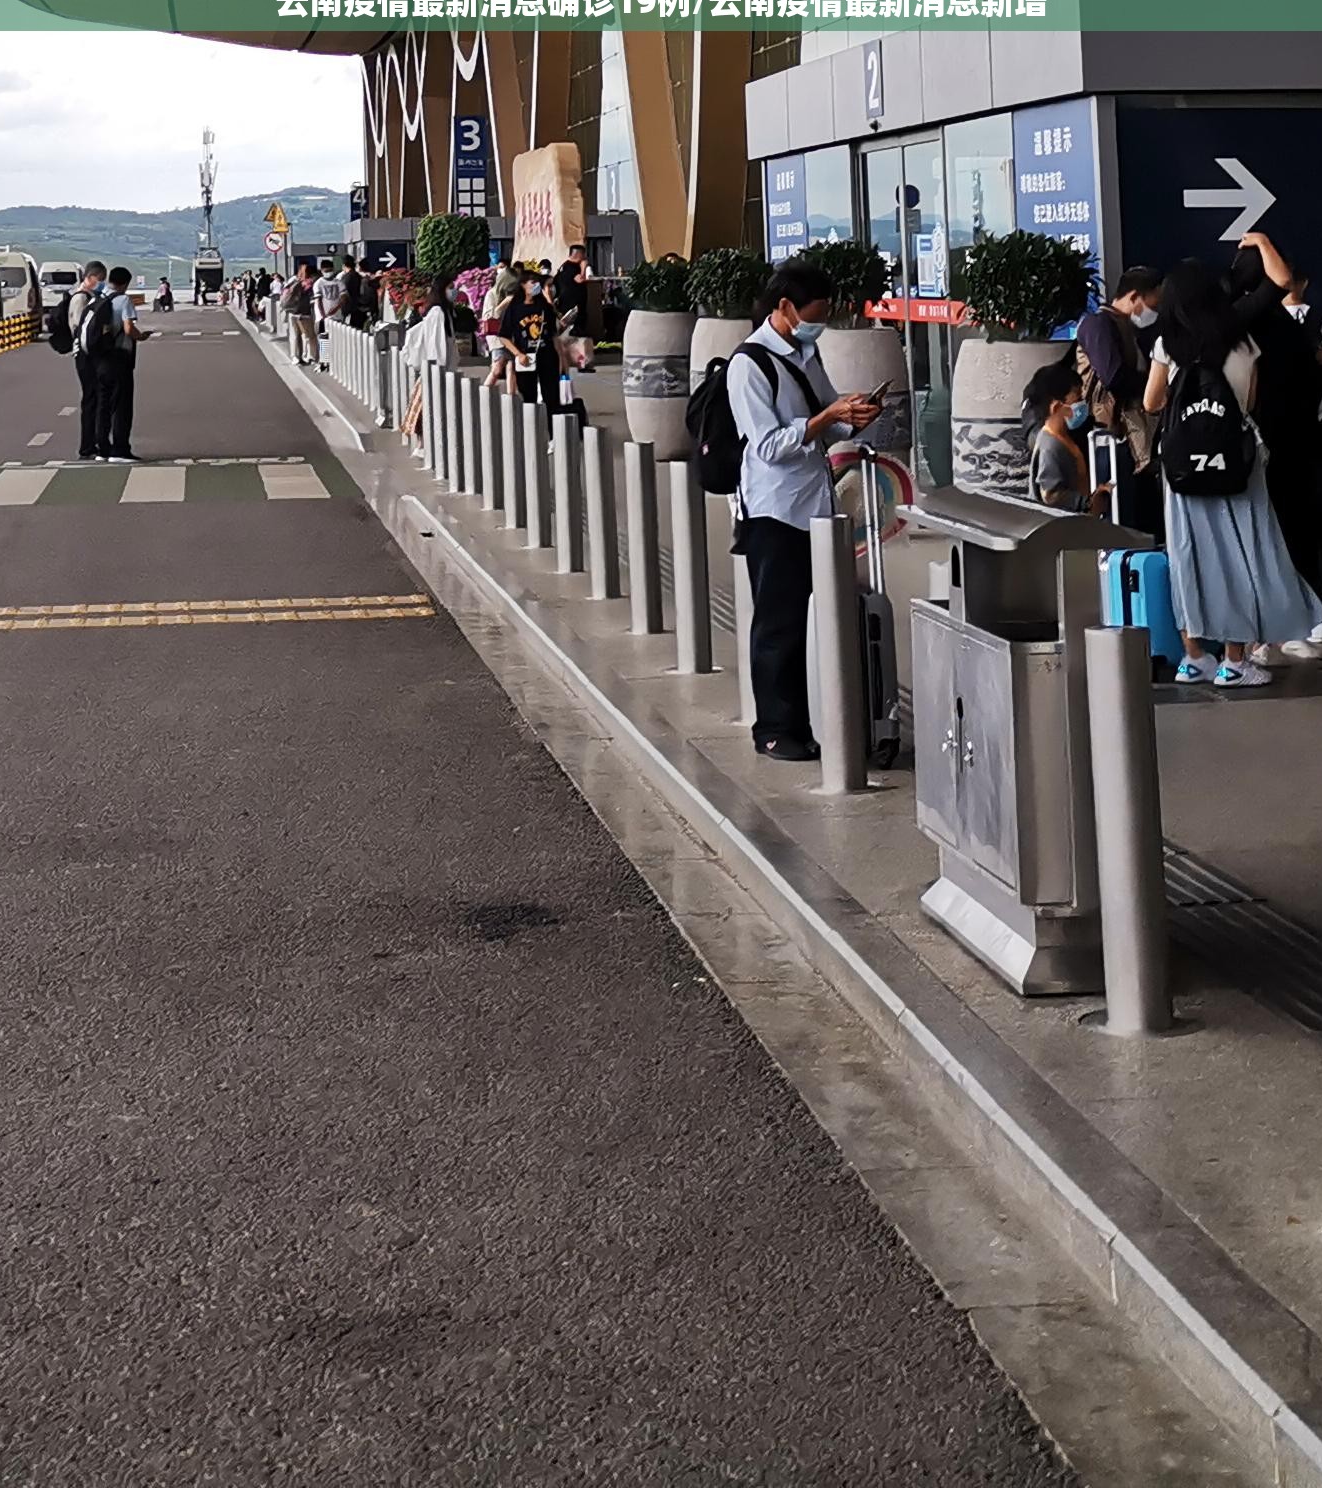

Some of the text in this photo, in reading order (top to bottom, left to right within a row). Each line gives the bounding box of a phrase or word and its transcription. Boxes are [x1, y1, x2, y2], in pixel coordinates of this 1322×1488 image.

[867, 51, 880, 110] 2
[460, 119, 481, 151] 3
[352, 189, 367, 207] 4
[328, 243, 336, 253] 4
[1190, 453, 1226, 471] 74
